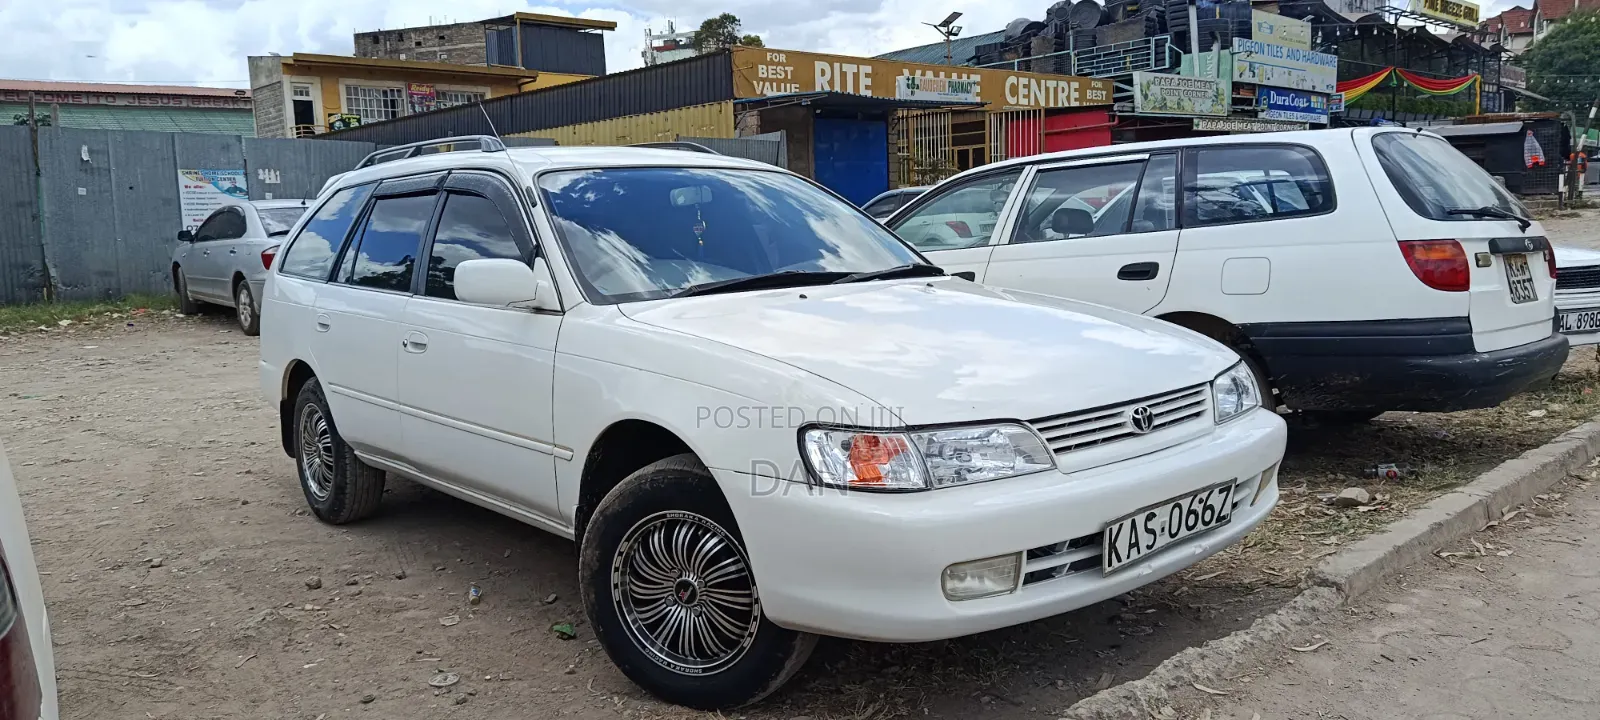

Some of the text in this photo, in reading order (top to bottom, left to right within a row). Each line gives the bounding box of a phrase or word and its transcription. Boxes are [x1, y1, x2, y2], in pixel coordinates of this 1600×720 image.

[767, 52, 787, 63] FOR
[1238, 39, 1265, 55] PIGEON
[1266, 44, 1283, 59] TILES
[1286, 47, 1301, 61] AND
[1302, 50, 1337, 68] HARDWARE
[758, 64, 794, 79] BEST
[814, 61, 872, 96] RITE
[753, 81, 800, 96] VALUE
[948, 81, 973, 94] PHARMACY
[1091, 80, 1103, 88] FOR
[1154, 77, 1214, 90] PAPA JOE MEAT
[1, 91, 83, 103] ELCOME
[92, 94, 117, 104] TO
[127, 95, 183, 105] JESUS
[1005, 75, 1080, 107] CENTRE
[1086, 90, 1107, 101] BEST
[1160, 87, 1212, 99] POINT CORNER
[1202, 120, 1221, 129] PAPA
[1223, 121, 1236, 130] JOE
[1237, 122, 1256, 130] MEAT
[1257, 123, 1275, 131] POINT
[701, 519, 726, 537] RACING
[1107, 484, 1233, 568] KAS 066Z
[644, 647, 668, 666] RACING
